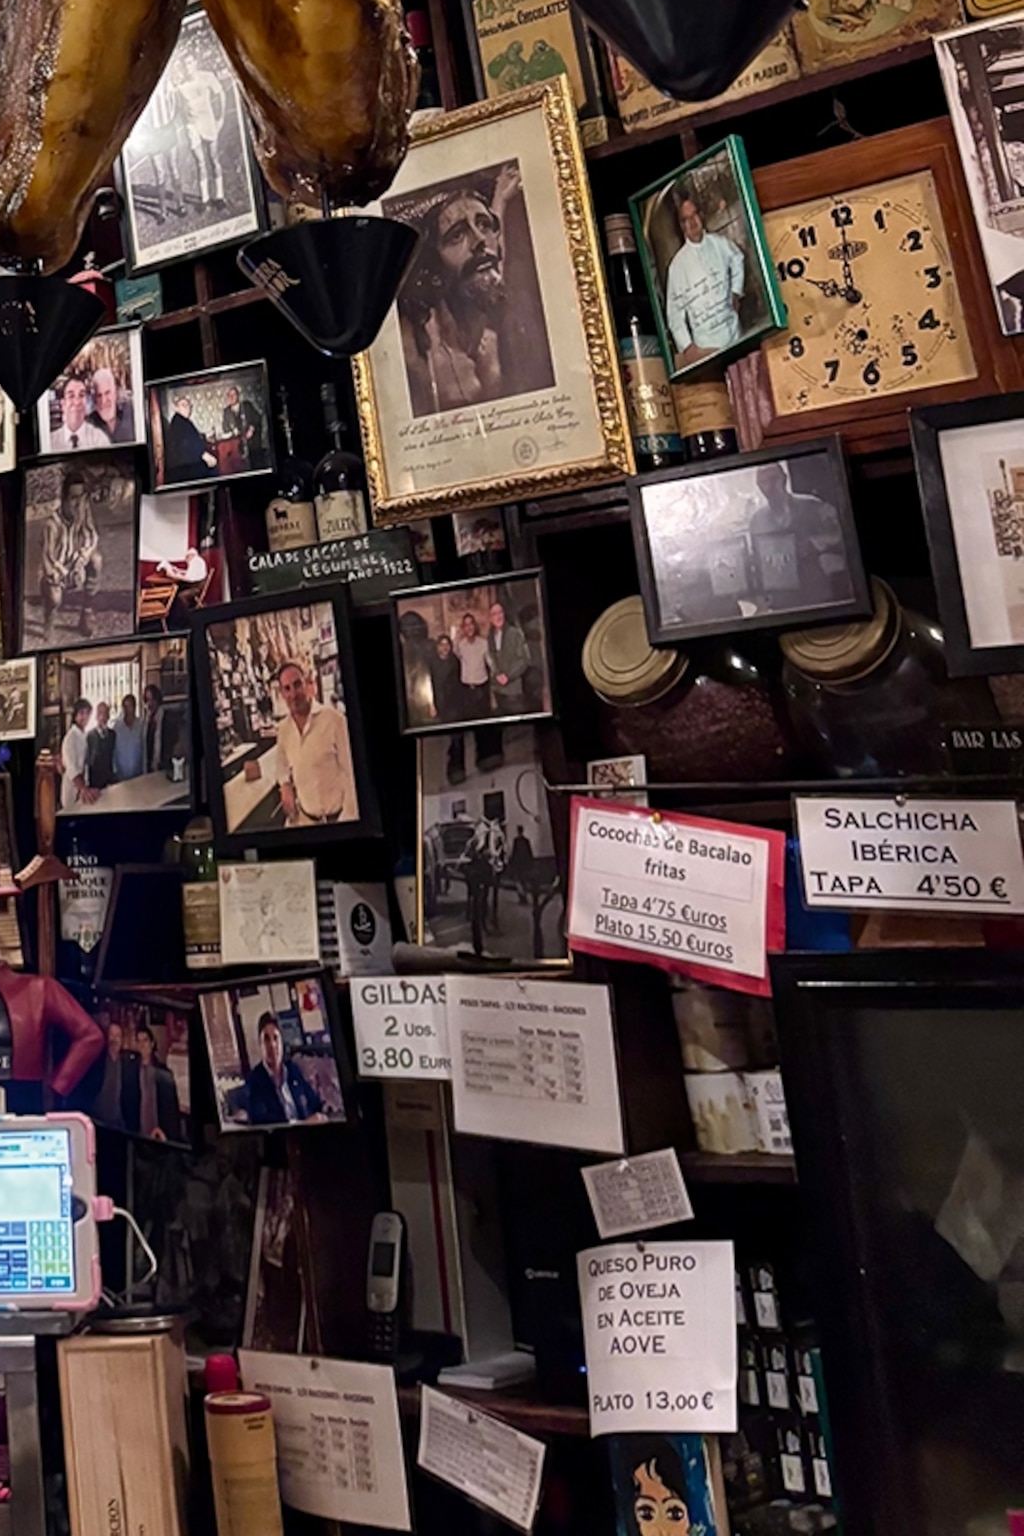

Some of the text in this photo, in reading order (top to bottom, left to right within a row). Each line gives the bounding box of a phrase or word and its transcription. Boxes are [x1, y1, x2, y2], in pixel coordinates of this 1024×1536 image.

[831, 206, 853, 227] 12
[874, 210, 885, 230] 1
[799, 226, 817, 247] 11
[907, 230, 923, 251] 2
[778, 259, 805, 281] 10
[924, 266, 941, 288] 3
[918, 309, 940, 330] 4
[789, 336, 805, 358] 8
[902, 344, 918, 365] 5
[824, 360, 840, 382] 7
[863, 361, 880, 385] 6
[304, 541, 347, 563] SACOS
[353, 536, 370, 551] DE
[302, 551, 387, 578] LEGUMBRES
[952, 730, 1022, 749] BAR LAS
[824, 807, 979, 832] SALCHICHA
[588, 820, 660, 849] Cocochas
[688, 838, 753, 866] Bacalao
[850, 838, 959, 864] IBÉRICA
[644, 857, 687, 881] fritas
[810, 871, 1008, 899] TAPA 4'50 €
[601, 887, 638, 911] Tapa
[642, 896, 676, 919] 4'75
[595, 913, 634, 937] Plato
[638, 923, 682, 947] 15,50
[361, 984, 446, 1006] GILDAS
[384, 1015, 400, 1036] 2
[362, 1047, 414, 1071] 3,80
[588, 1253, 697, 1278] QUESO PURO
[598, 1281, 681, 1302] DE OVEJA
[597, 1308, 685, 1330] EN ACEITE
[610, 1334, 666, 1356] AOVE
[593, 1393, 634, 1412] PLATO
